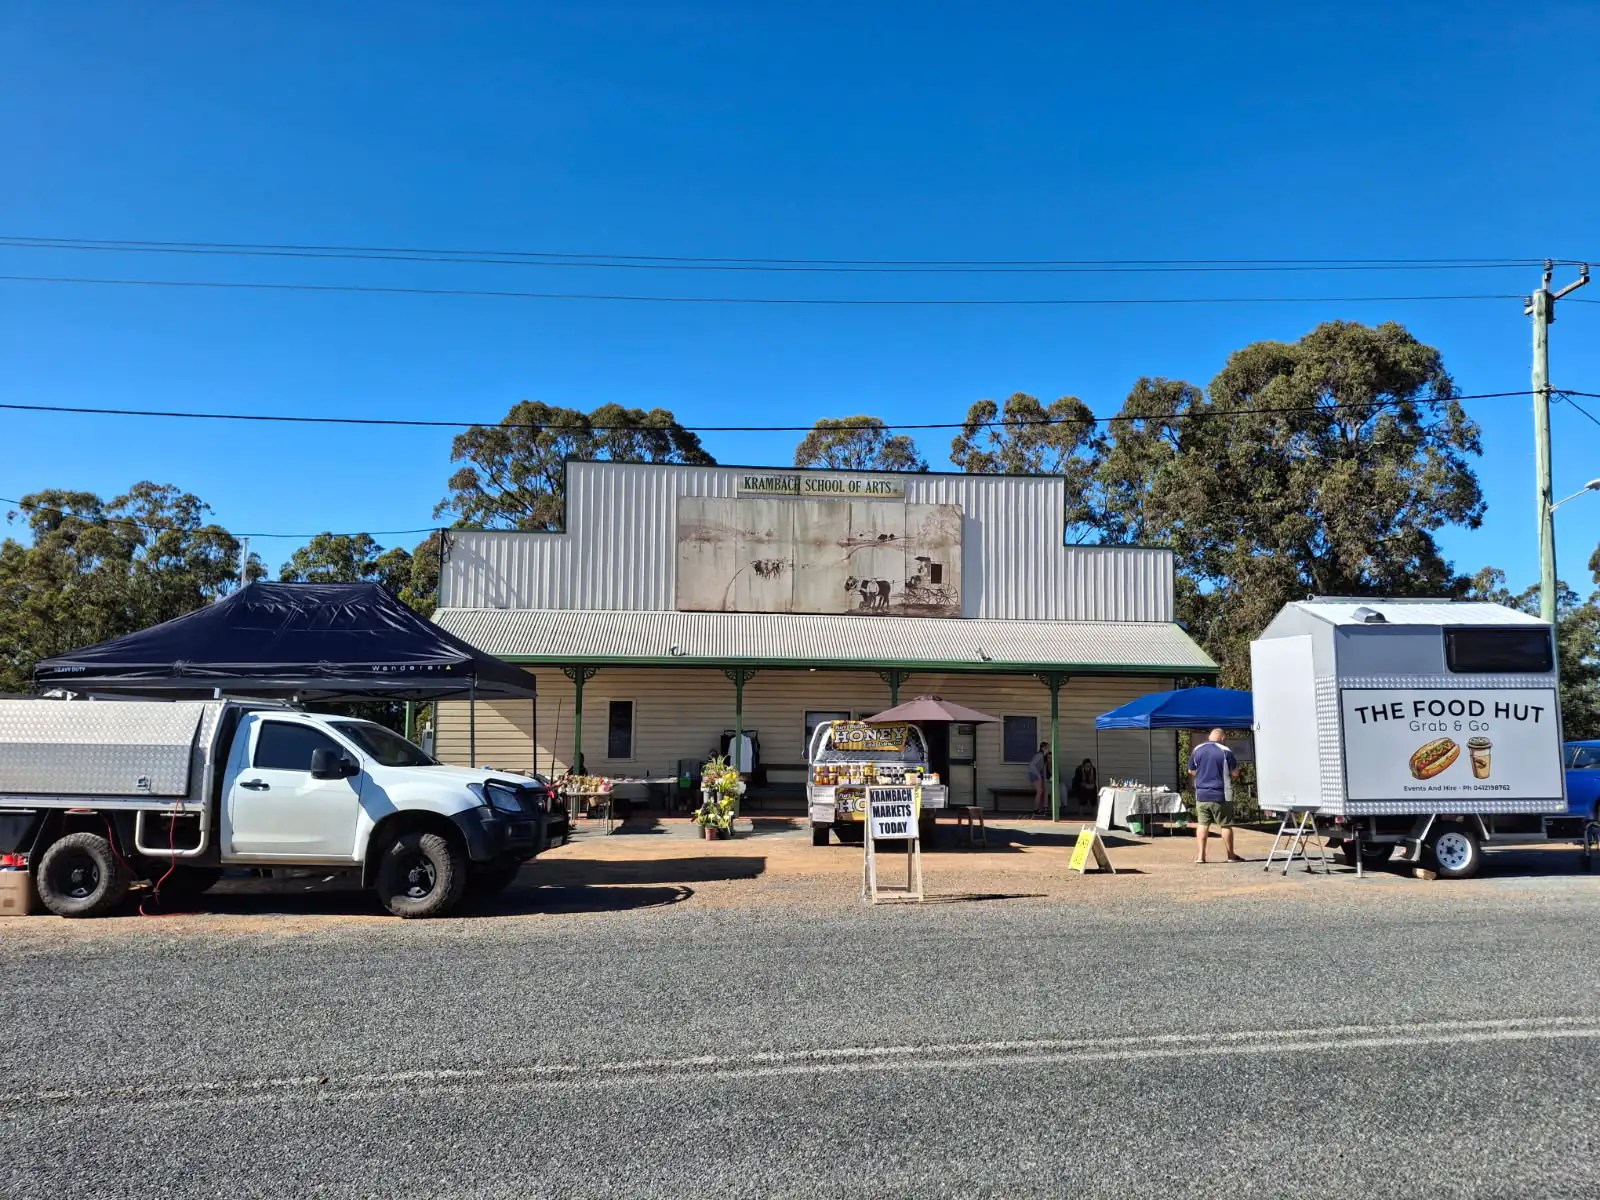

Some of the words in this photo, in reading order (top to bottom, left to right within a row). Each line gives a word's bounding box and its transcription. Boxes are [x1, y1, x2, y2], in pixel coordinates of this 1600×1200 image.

[744, 476, 800, 491] KRAMBACH
[805, 479, 845, 493] SCHOOL
[849, 480, 861, 493] OF
[865, 481, 892, 494] ARTS
[1354, 702, 1405, 724] THE
[1413, 699, 1485, 718] FOOD
[1494, 701, 1544, 723] HUT
[1409, 719, 1448, 732] Grab
[1453, 720, 1462, 731] &
[1468, 720, 1490, 732] Go
[834, 727, 906, 743] HONEY
[870, 789, 913, 802] KRAMBACH
[872, 804, 912, 819] MARKETS
[878, 821, 908, 835] TODAY
